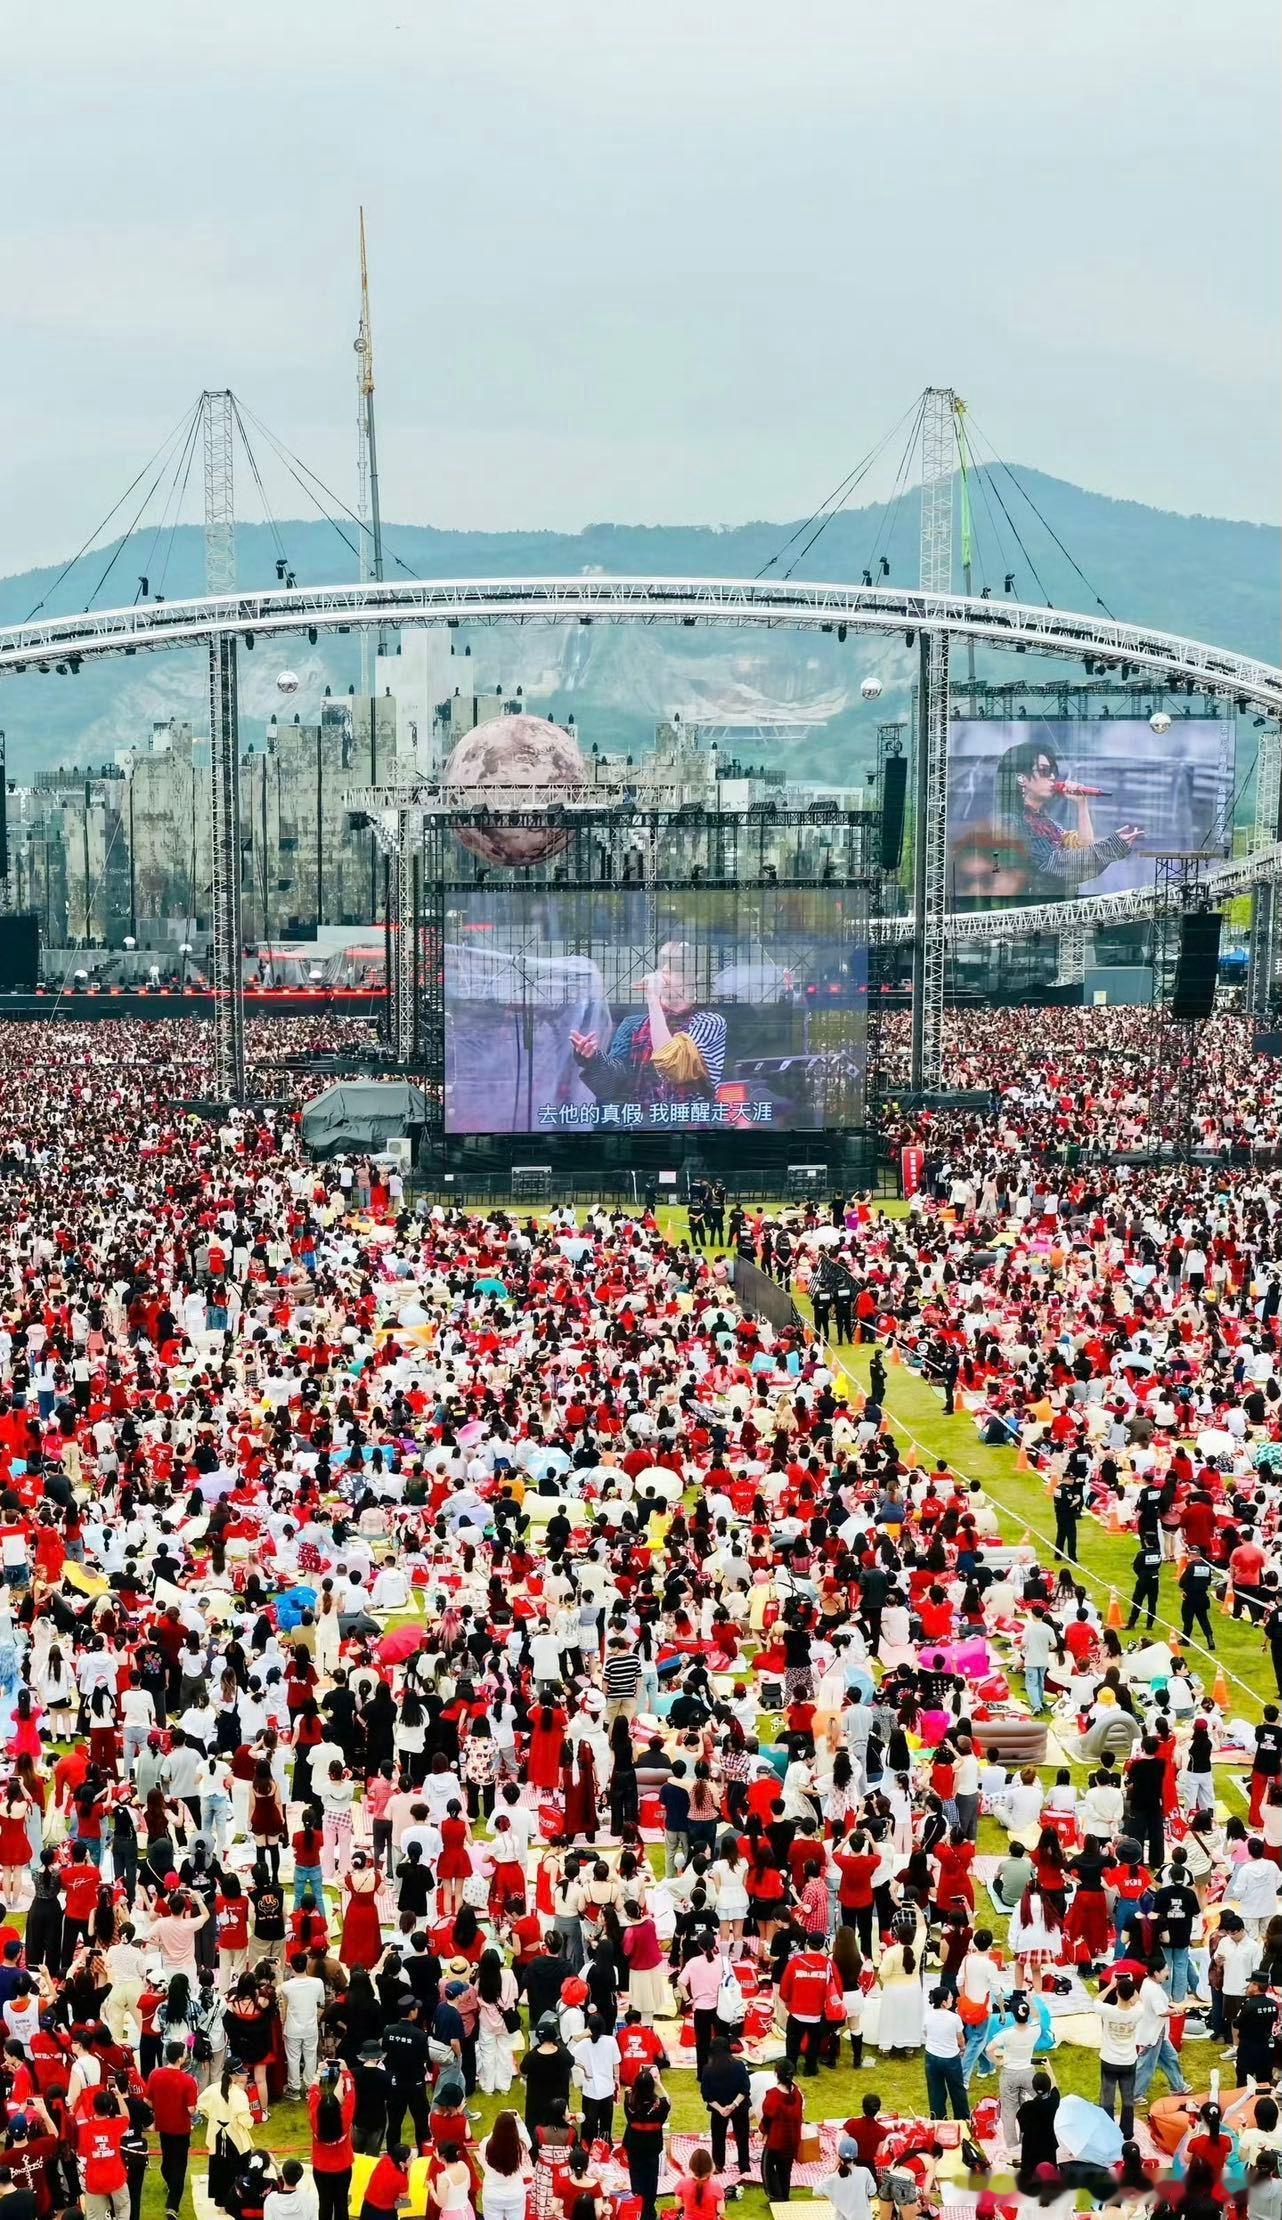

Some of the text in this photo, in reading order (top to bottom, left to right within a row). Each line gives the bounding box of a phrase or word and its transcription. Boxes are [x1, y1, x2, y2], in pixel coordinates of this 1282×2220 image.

[538, 1101, 773, 1124] 去他的真假 我睡醒走天涯
